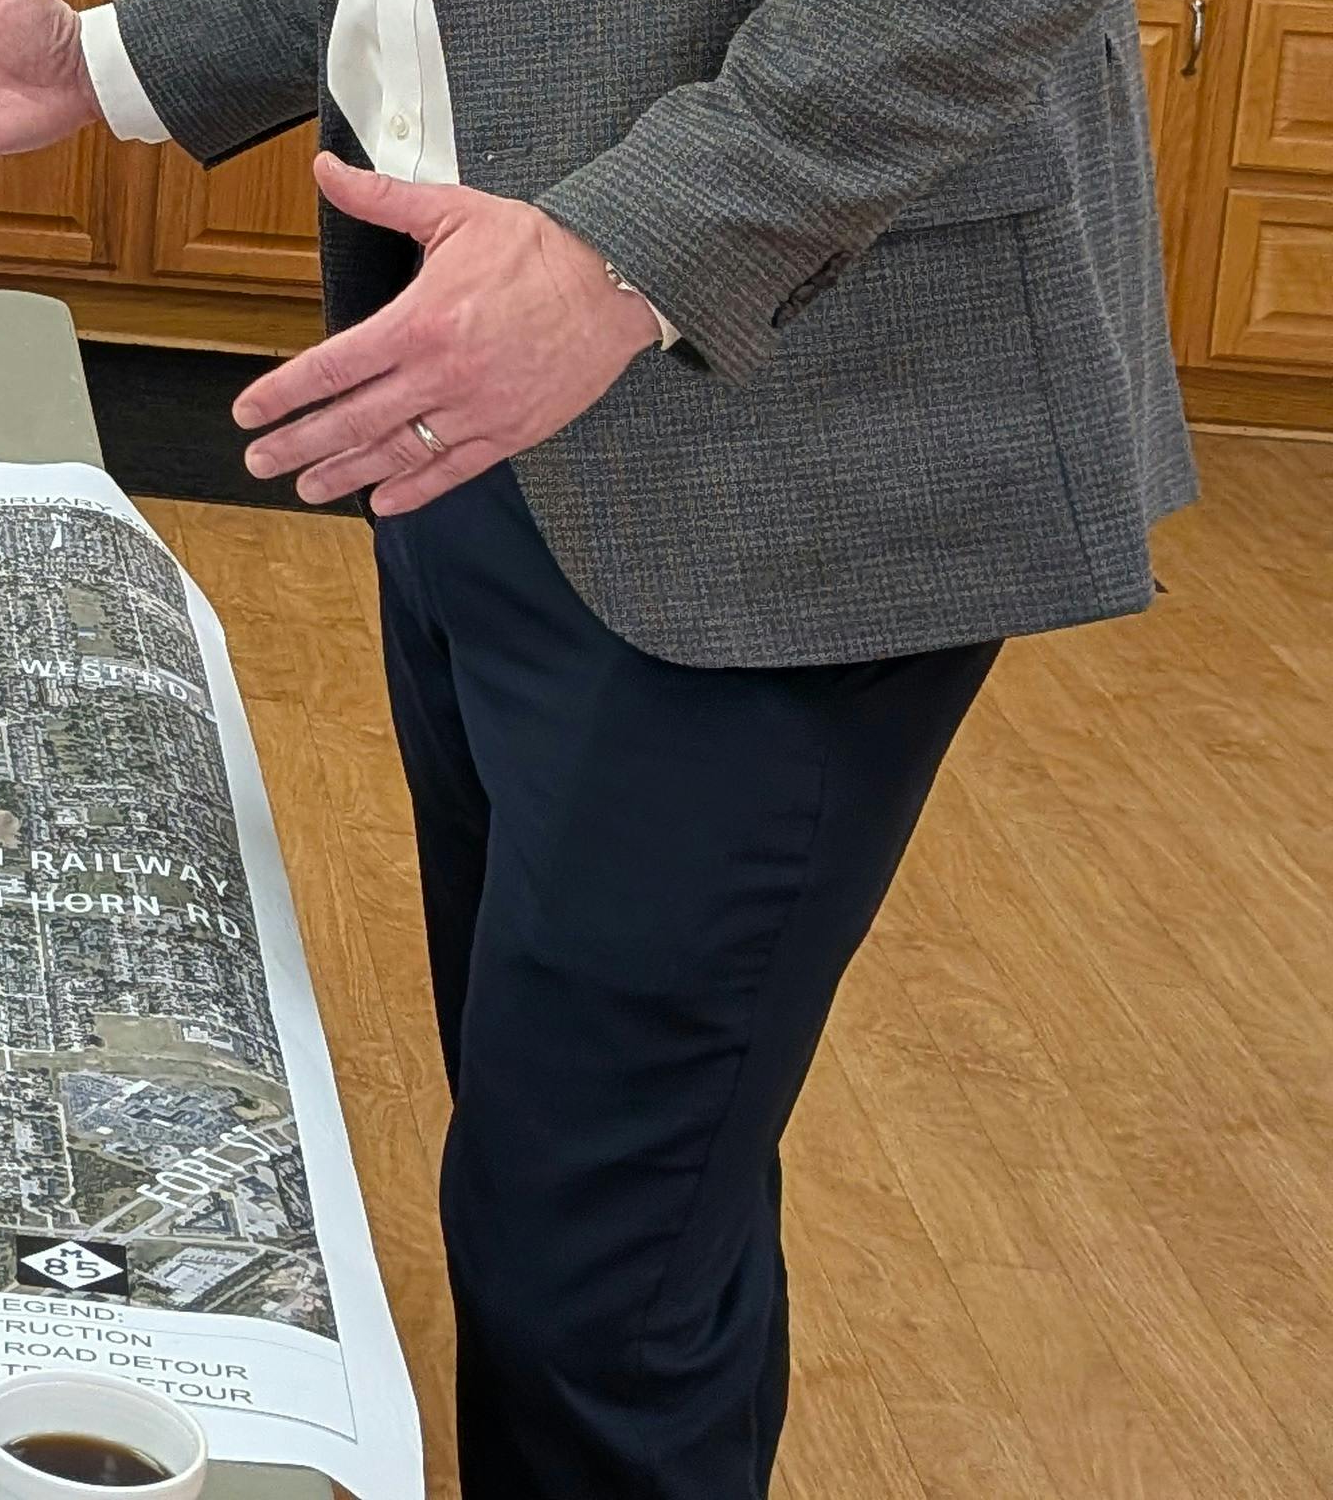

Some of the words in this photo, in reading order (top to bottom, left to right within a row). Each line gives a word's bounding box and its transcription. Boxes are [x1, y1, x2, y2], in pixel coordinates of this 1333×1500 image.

[21, 658, 123, 682] WEST
[138, 671, 188, 700] RD
[31, 851, 230, 897] RAILWAY
[31, 891, 162, 918] HORN
[187, 902, 241, 941] RD
[136, 1146, 246, 1209] FORT
[220, 1124, 284, 1163] ST
[43, 1258, 102, 1279] 85
[60, 1247, 82, 1259] M
[4, 1341, 97, 1363] ROAD
[108, 1351, 249, 1380] DETOUR
[123, 1375, 255, 1405] ETOUR
